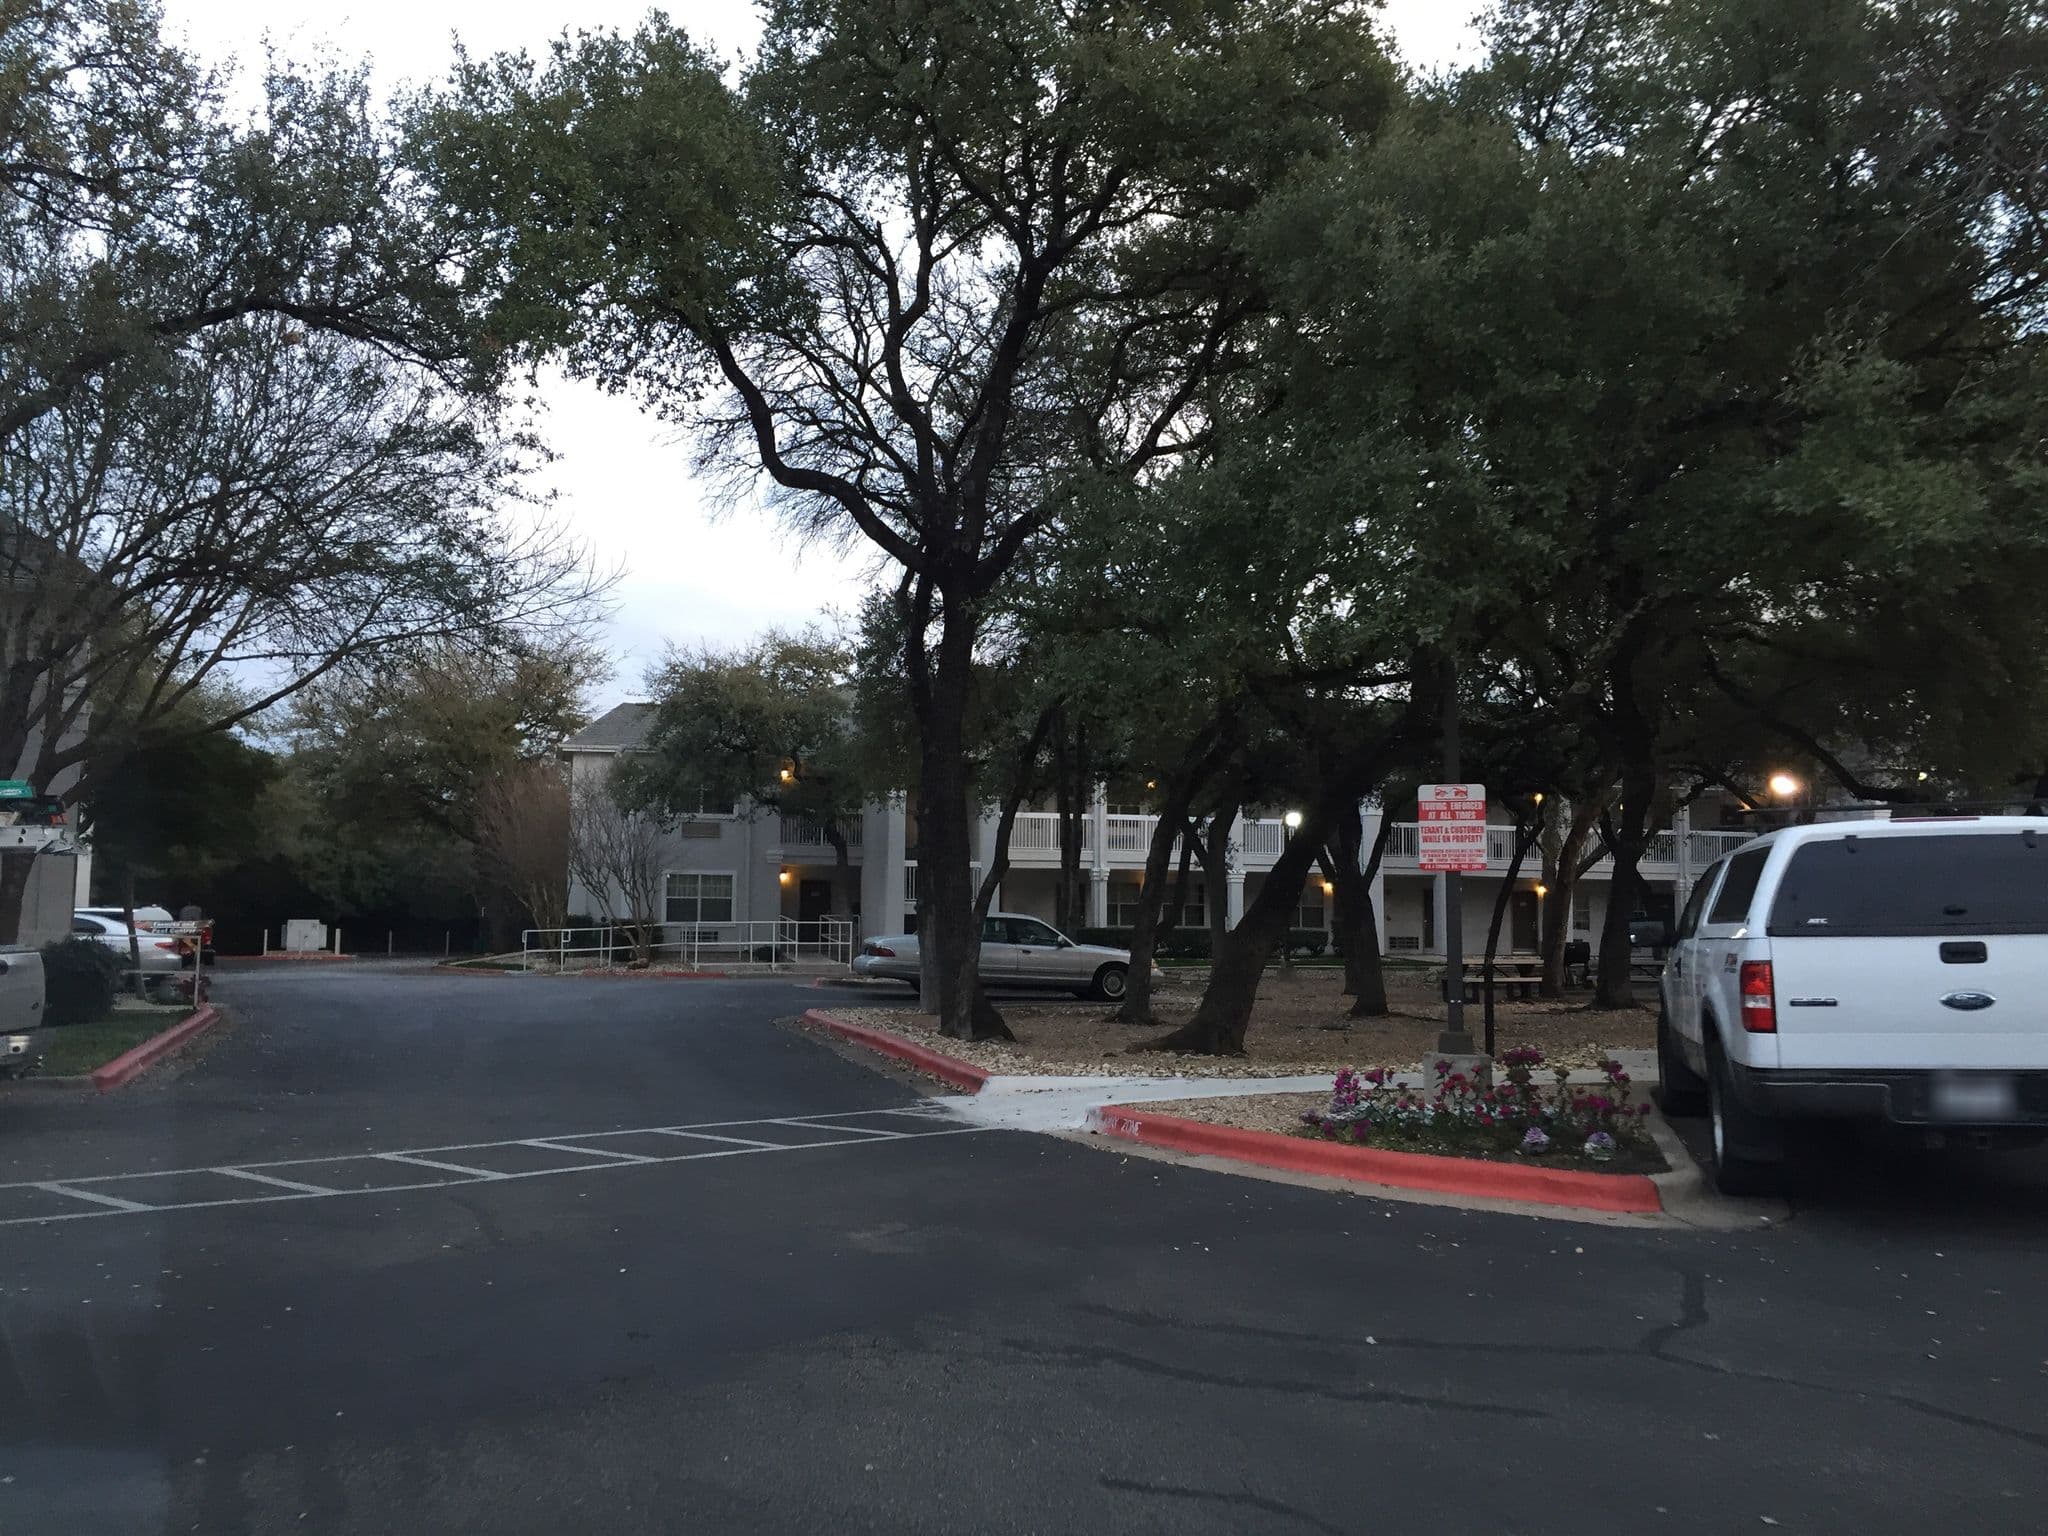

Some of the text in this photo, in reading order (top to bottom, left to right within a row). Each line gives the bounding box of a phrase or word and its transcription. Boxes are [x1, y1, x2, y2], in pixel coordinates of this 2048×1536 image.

[1421, 801, 1483, 811] TOWING ENFORCED
[1428, 811, 1477, 820] AT ALL TIMES
[1420, 826, 1485, 834] TENANT & CUSTOMER
[1422, 834, 1483, 843] WHILE ON PROPERTY
